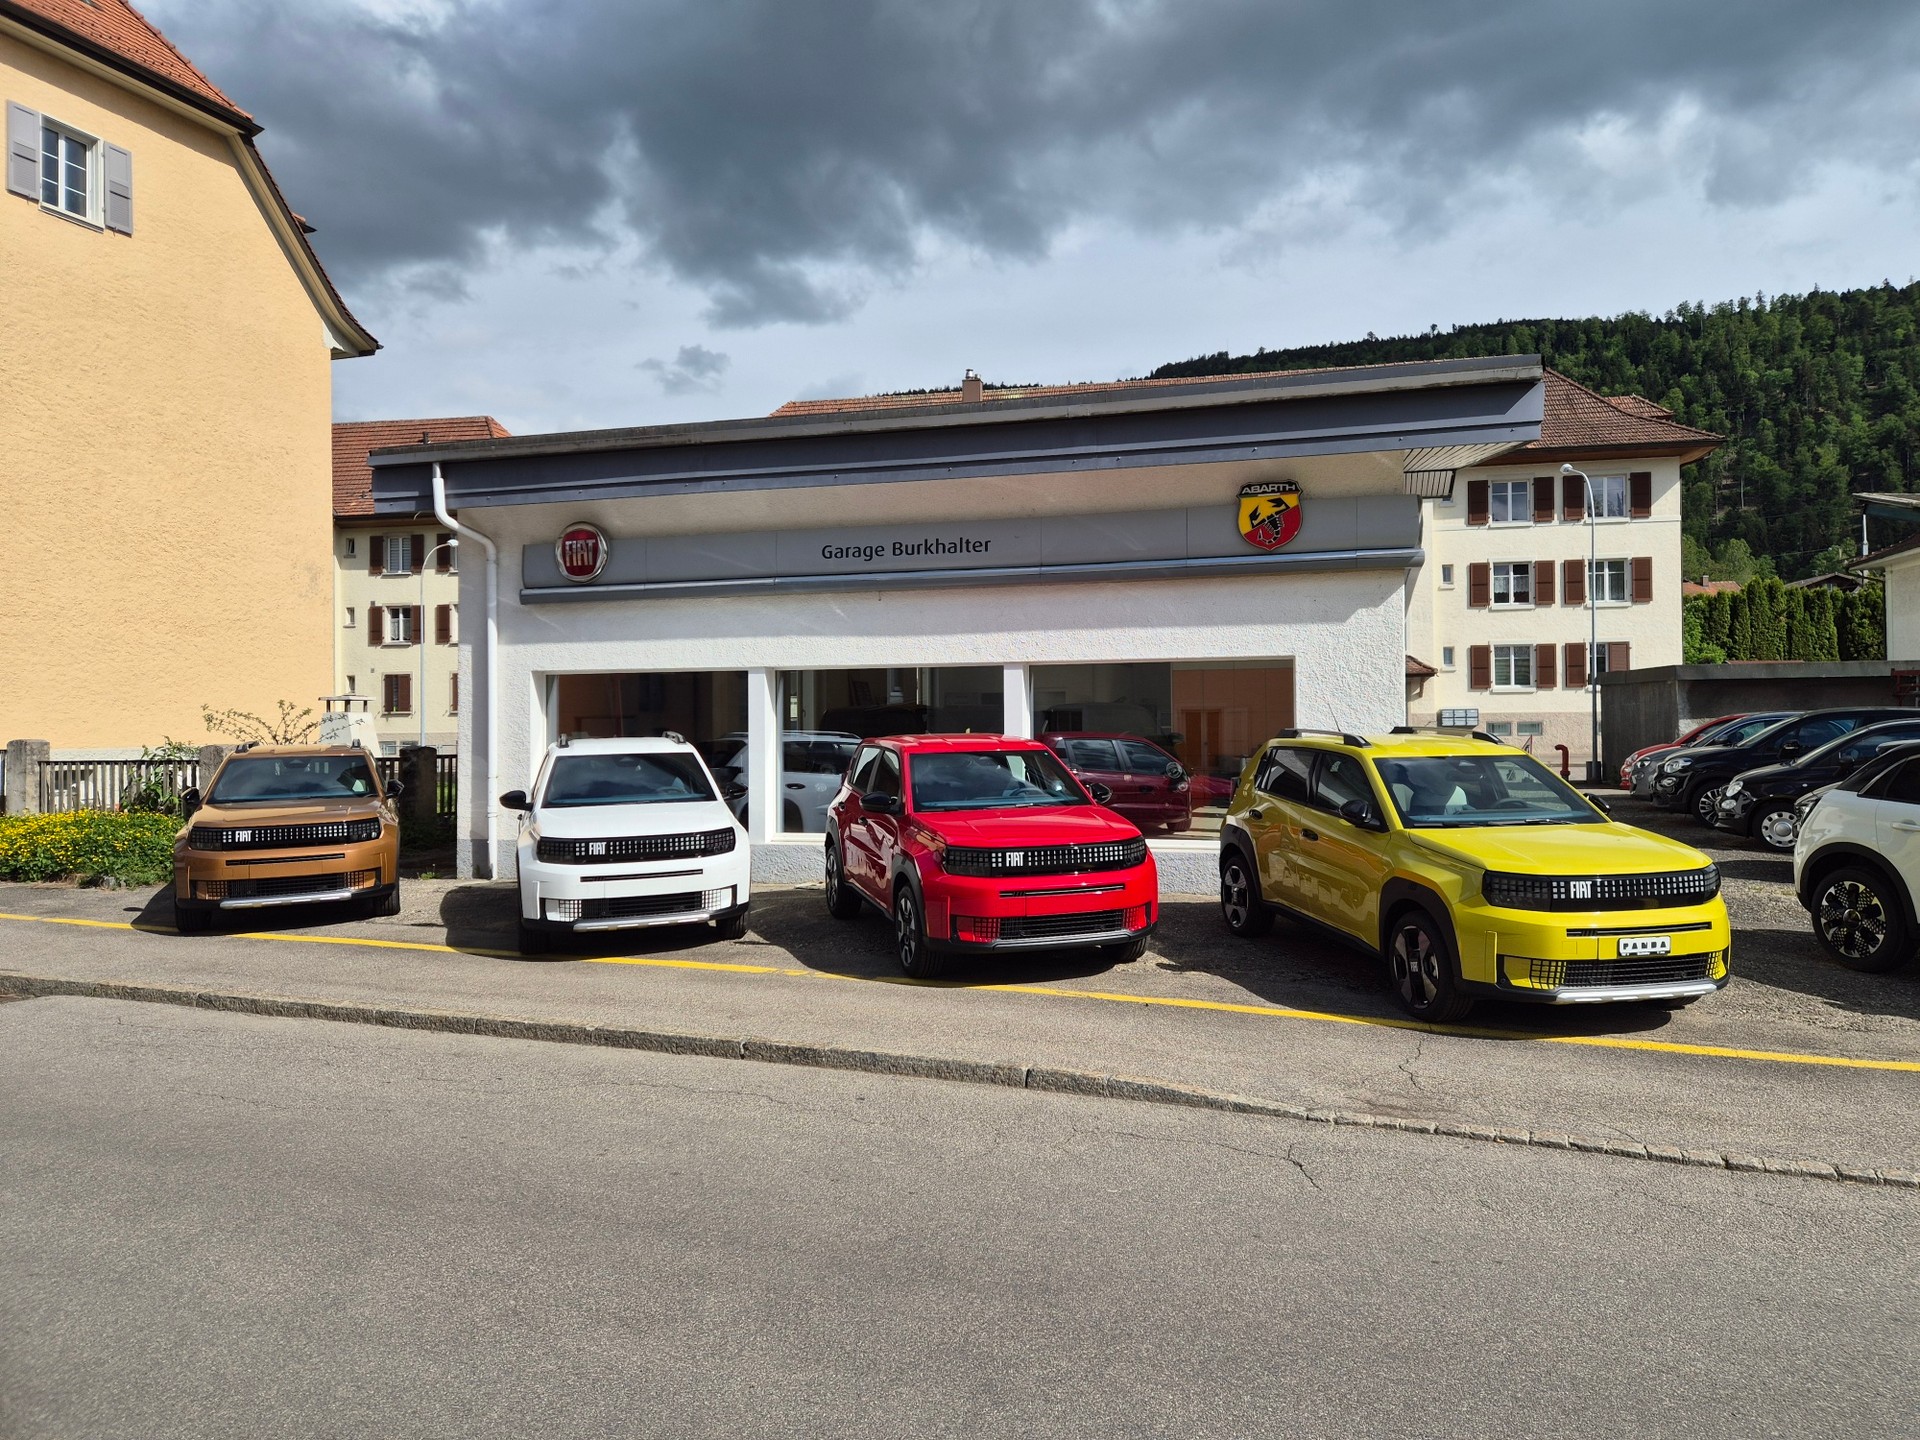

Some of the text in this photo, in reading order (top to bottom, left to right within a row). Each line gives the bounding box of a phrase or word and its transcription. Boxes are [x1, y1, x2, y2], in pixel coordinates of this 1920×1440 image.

[1242, 483, 1296, 494] ABARTH
[564, 539, 596, 567] FIAT
[821, 537, 991, 561] Garage Burkhalter
[235, 830, 252, 842] FIAT
[589, 842, 607, 856] FIAT
[1005, 851, 1025, 867] FIAT
[1570, 880, 1592, 899] FIAT
[1622, 941, 1667, 950] PANDA
